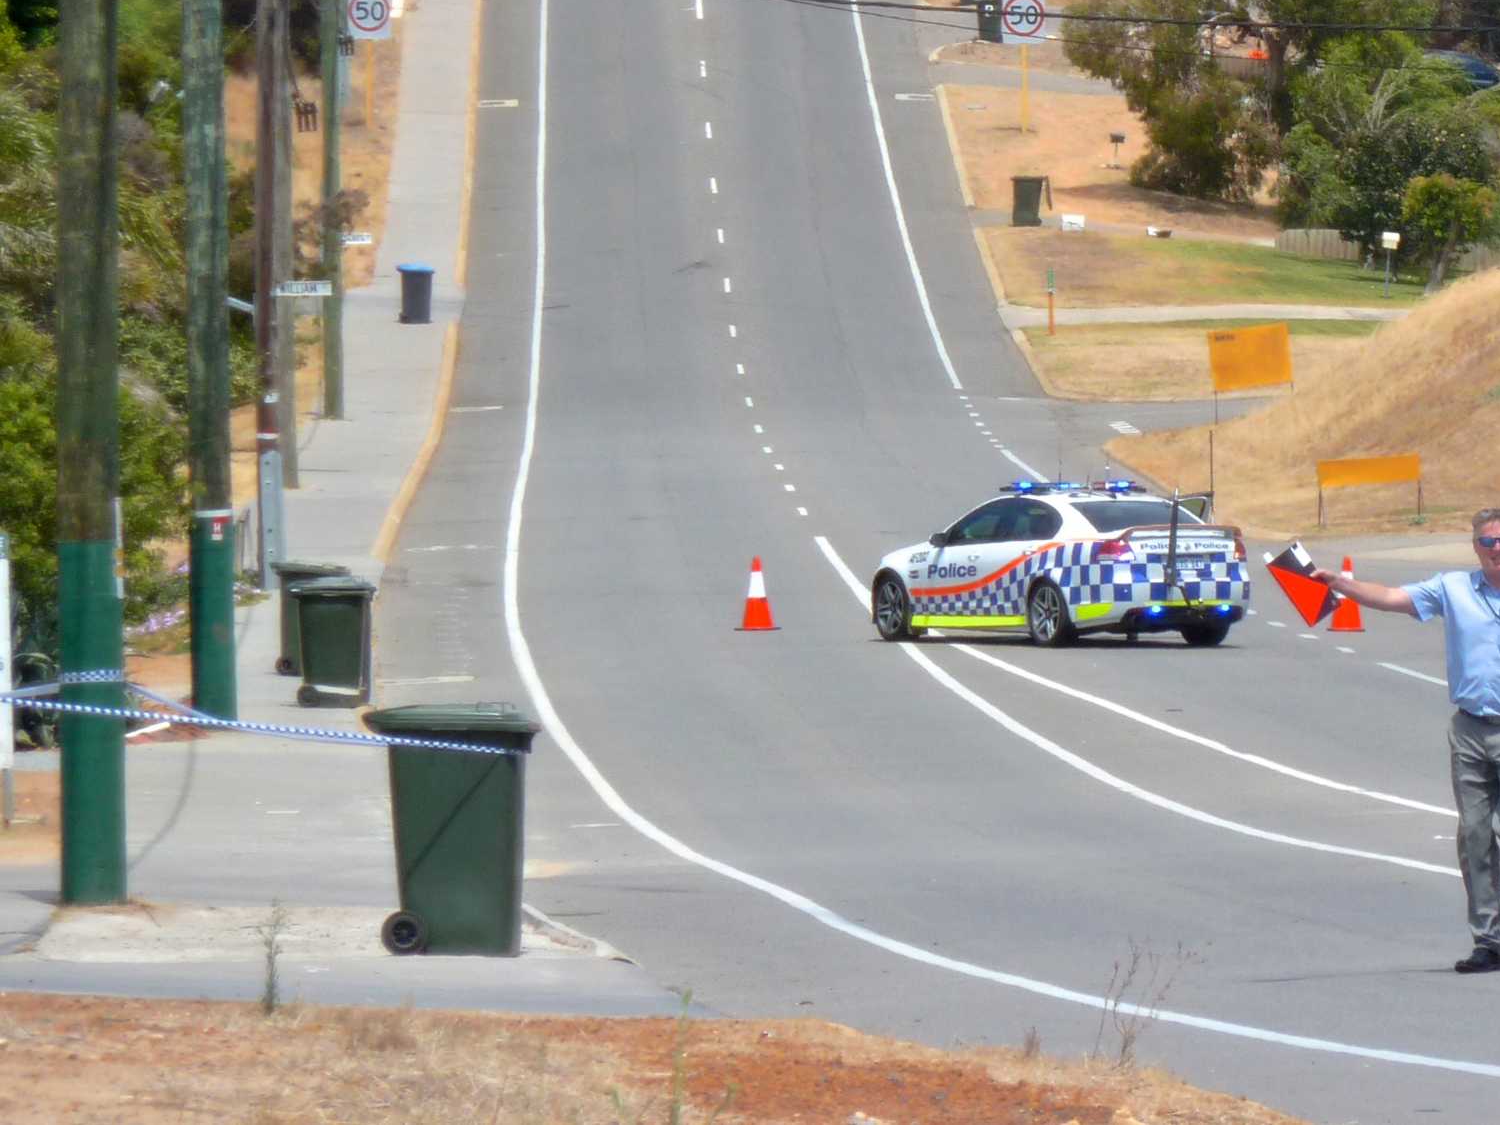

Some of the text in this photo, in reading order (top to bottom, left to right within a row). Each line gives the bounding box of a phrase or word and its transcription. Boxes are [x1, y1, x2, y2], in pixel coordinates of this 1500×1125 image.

[356, 1, 385, 21] 50
[1010, 5, 1038, 25] 50
[1193, 541, 1229, 550] Police
[928, 563, 977, 579] Police
